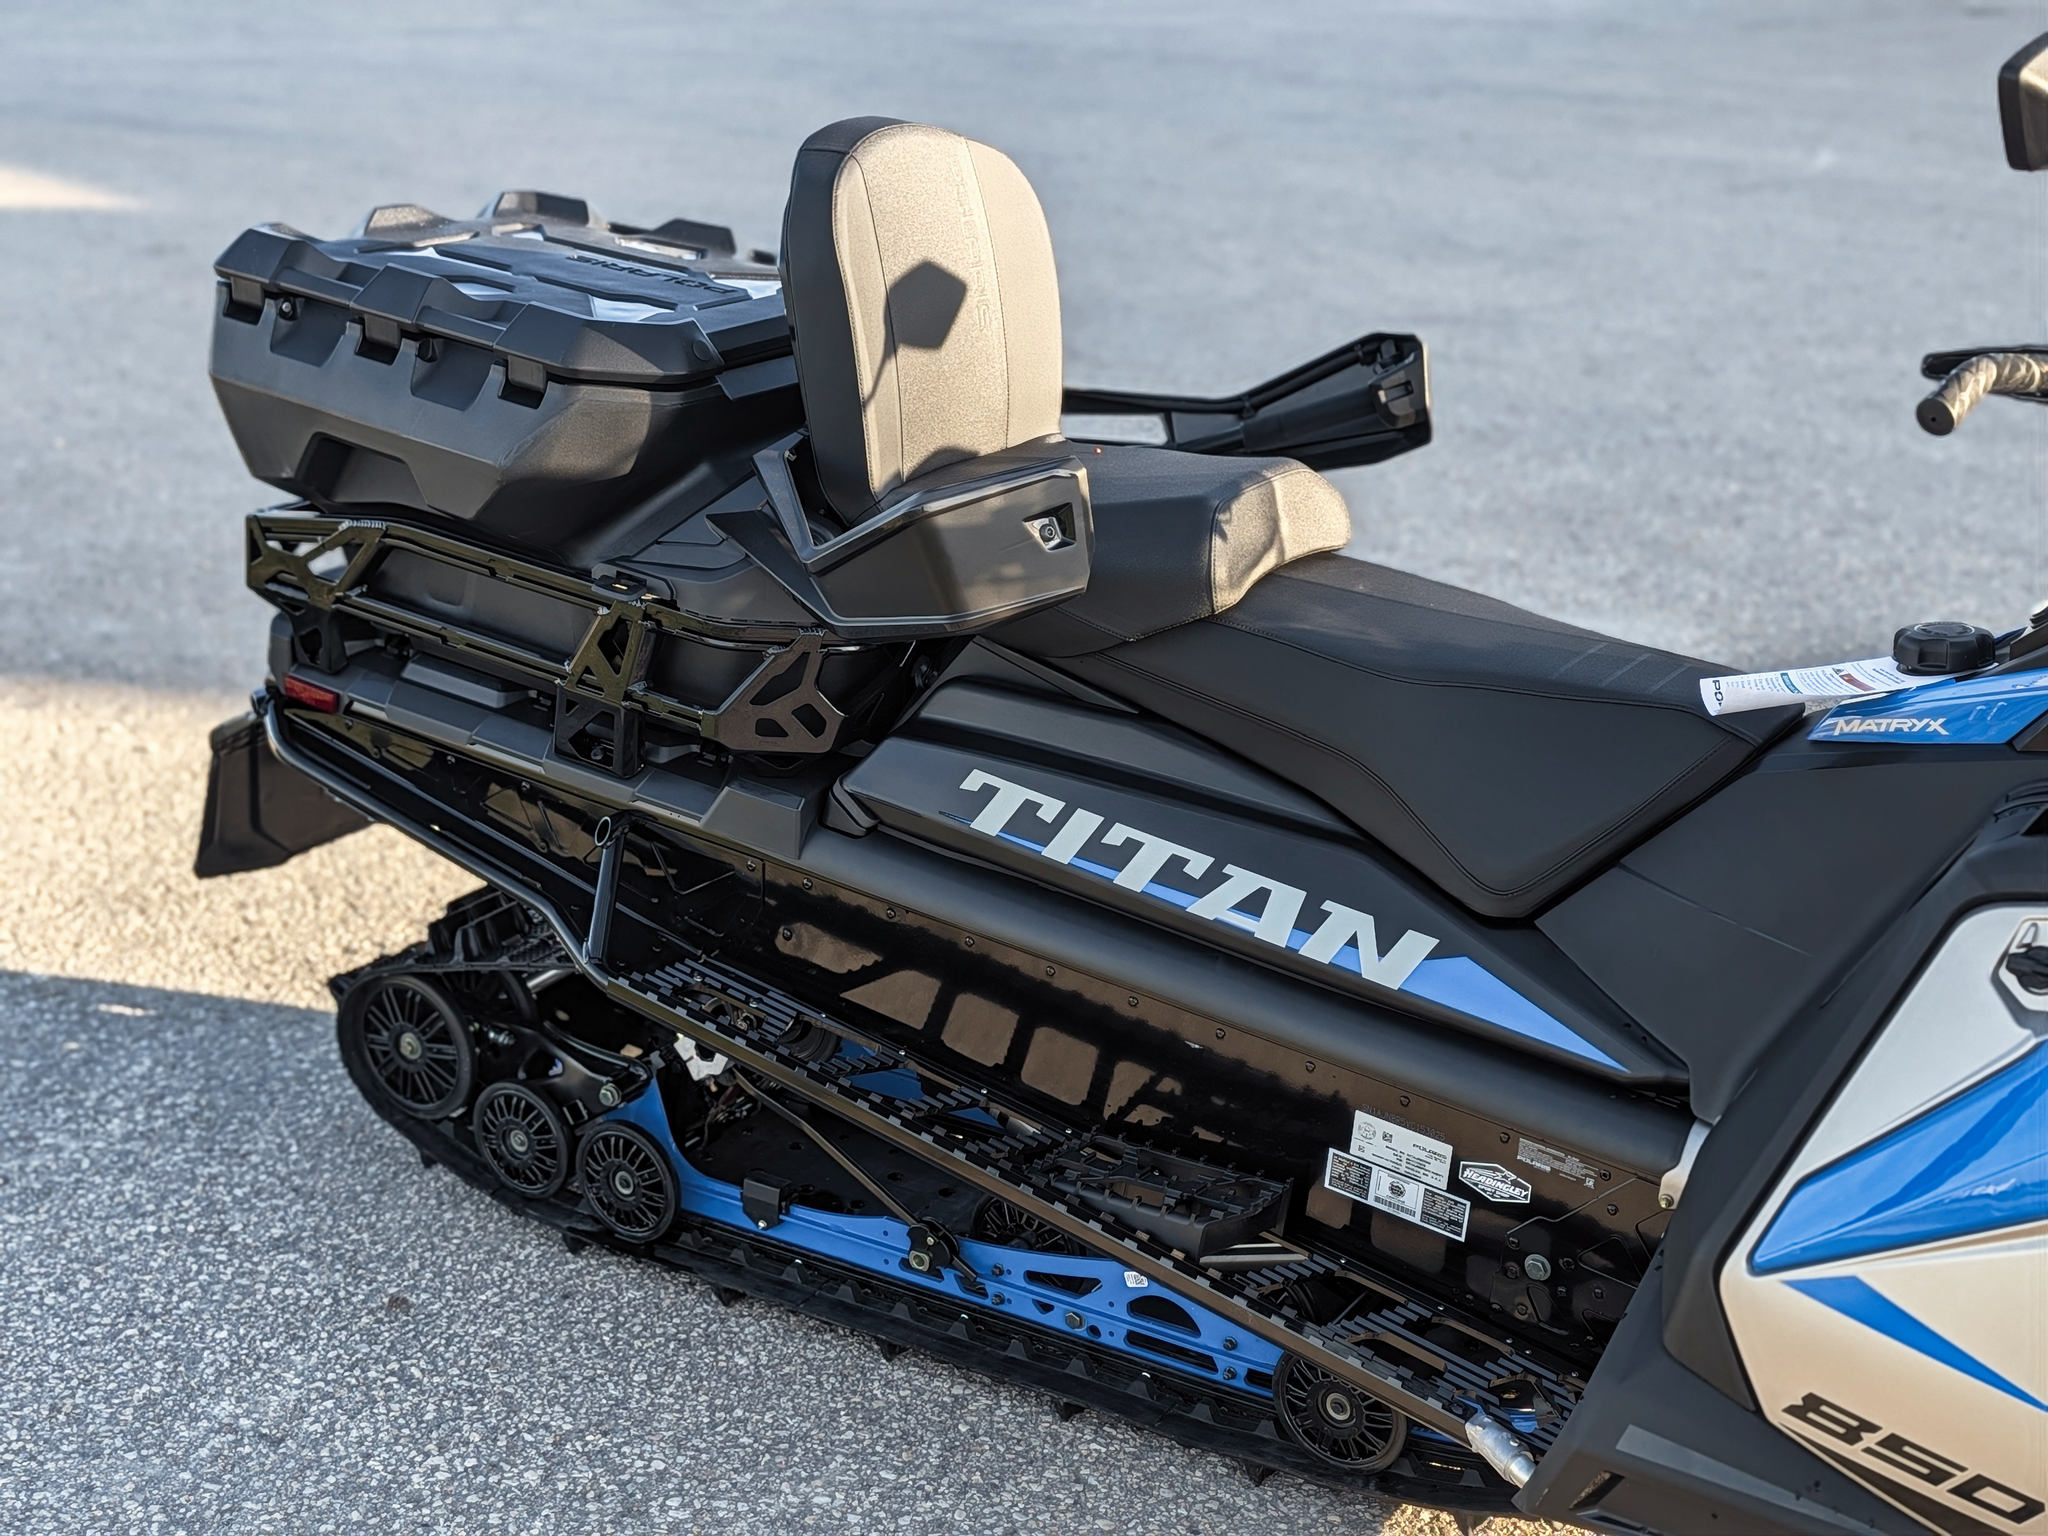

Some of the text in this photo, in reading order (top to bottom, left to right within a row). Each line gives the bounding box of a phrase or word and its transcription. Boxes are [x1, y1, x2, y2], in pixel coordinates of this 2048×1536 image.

[566, 255, 739, 294] POLARIS
[1833, 717, 1950, 736] MATRYX
[959, 768, 1440, 990] TITAN
[1463, 1168, 1529, 1197] HEADINGLEY
[1781, 1392, 2046, 1525] 850
